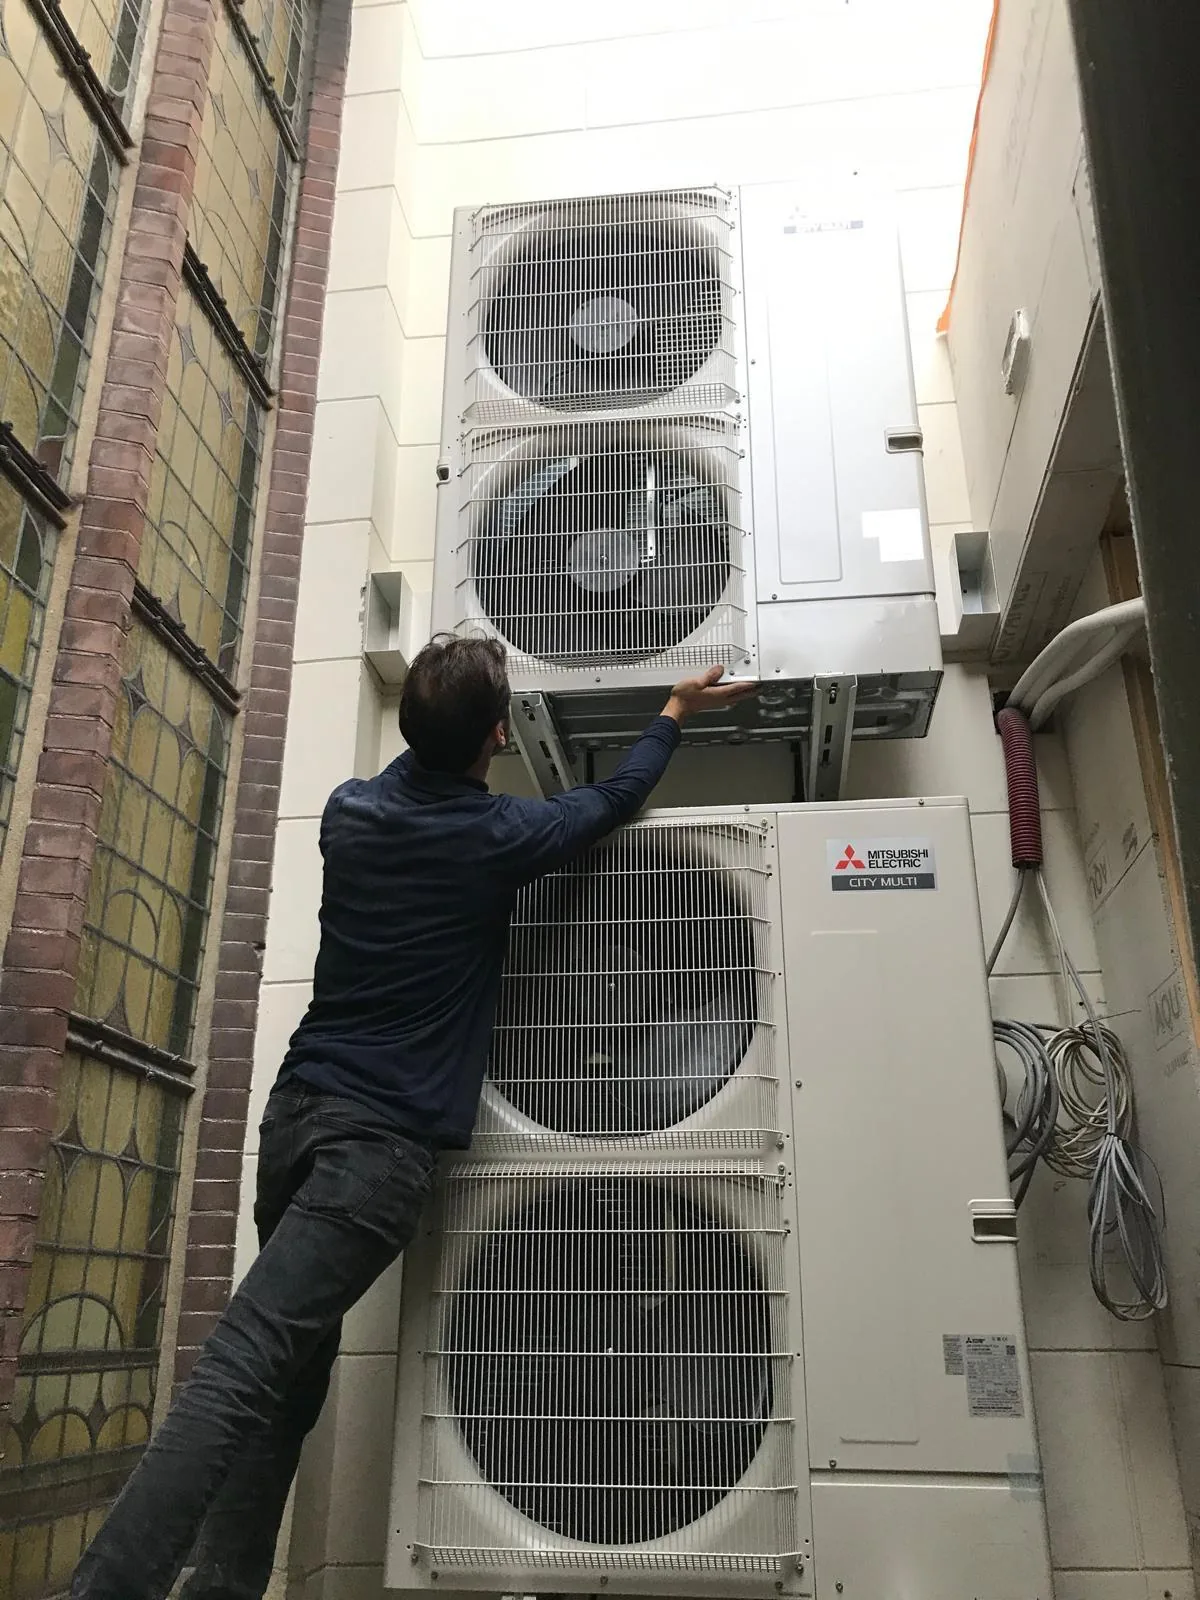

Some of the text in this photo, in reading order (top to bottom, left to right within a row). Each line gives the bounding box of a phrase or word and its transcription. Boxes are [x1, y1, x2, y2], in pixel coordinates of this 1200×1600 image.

[867, 849, 928, 859] MITSUBISHI
[868, 859, 921, 868] ELECTRIC
[849, 877, 918, 887] CITY MULTI
